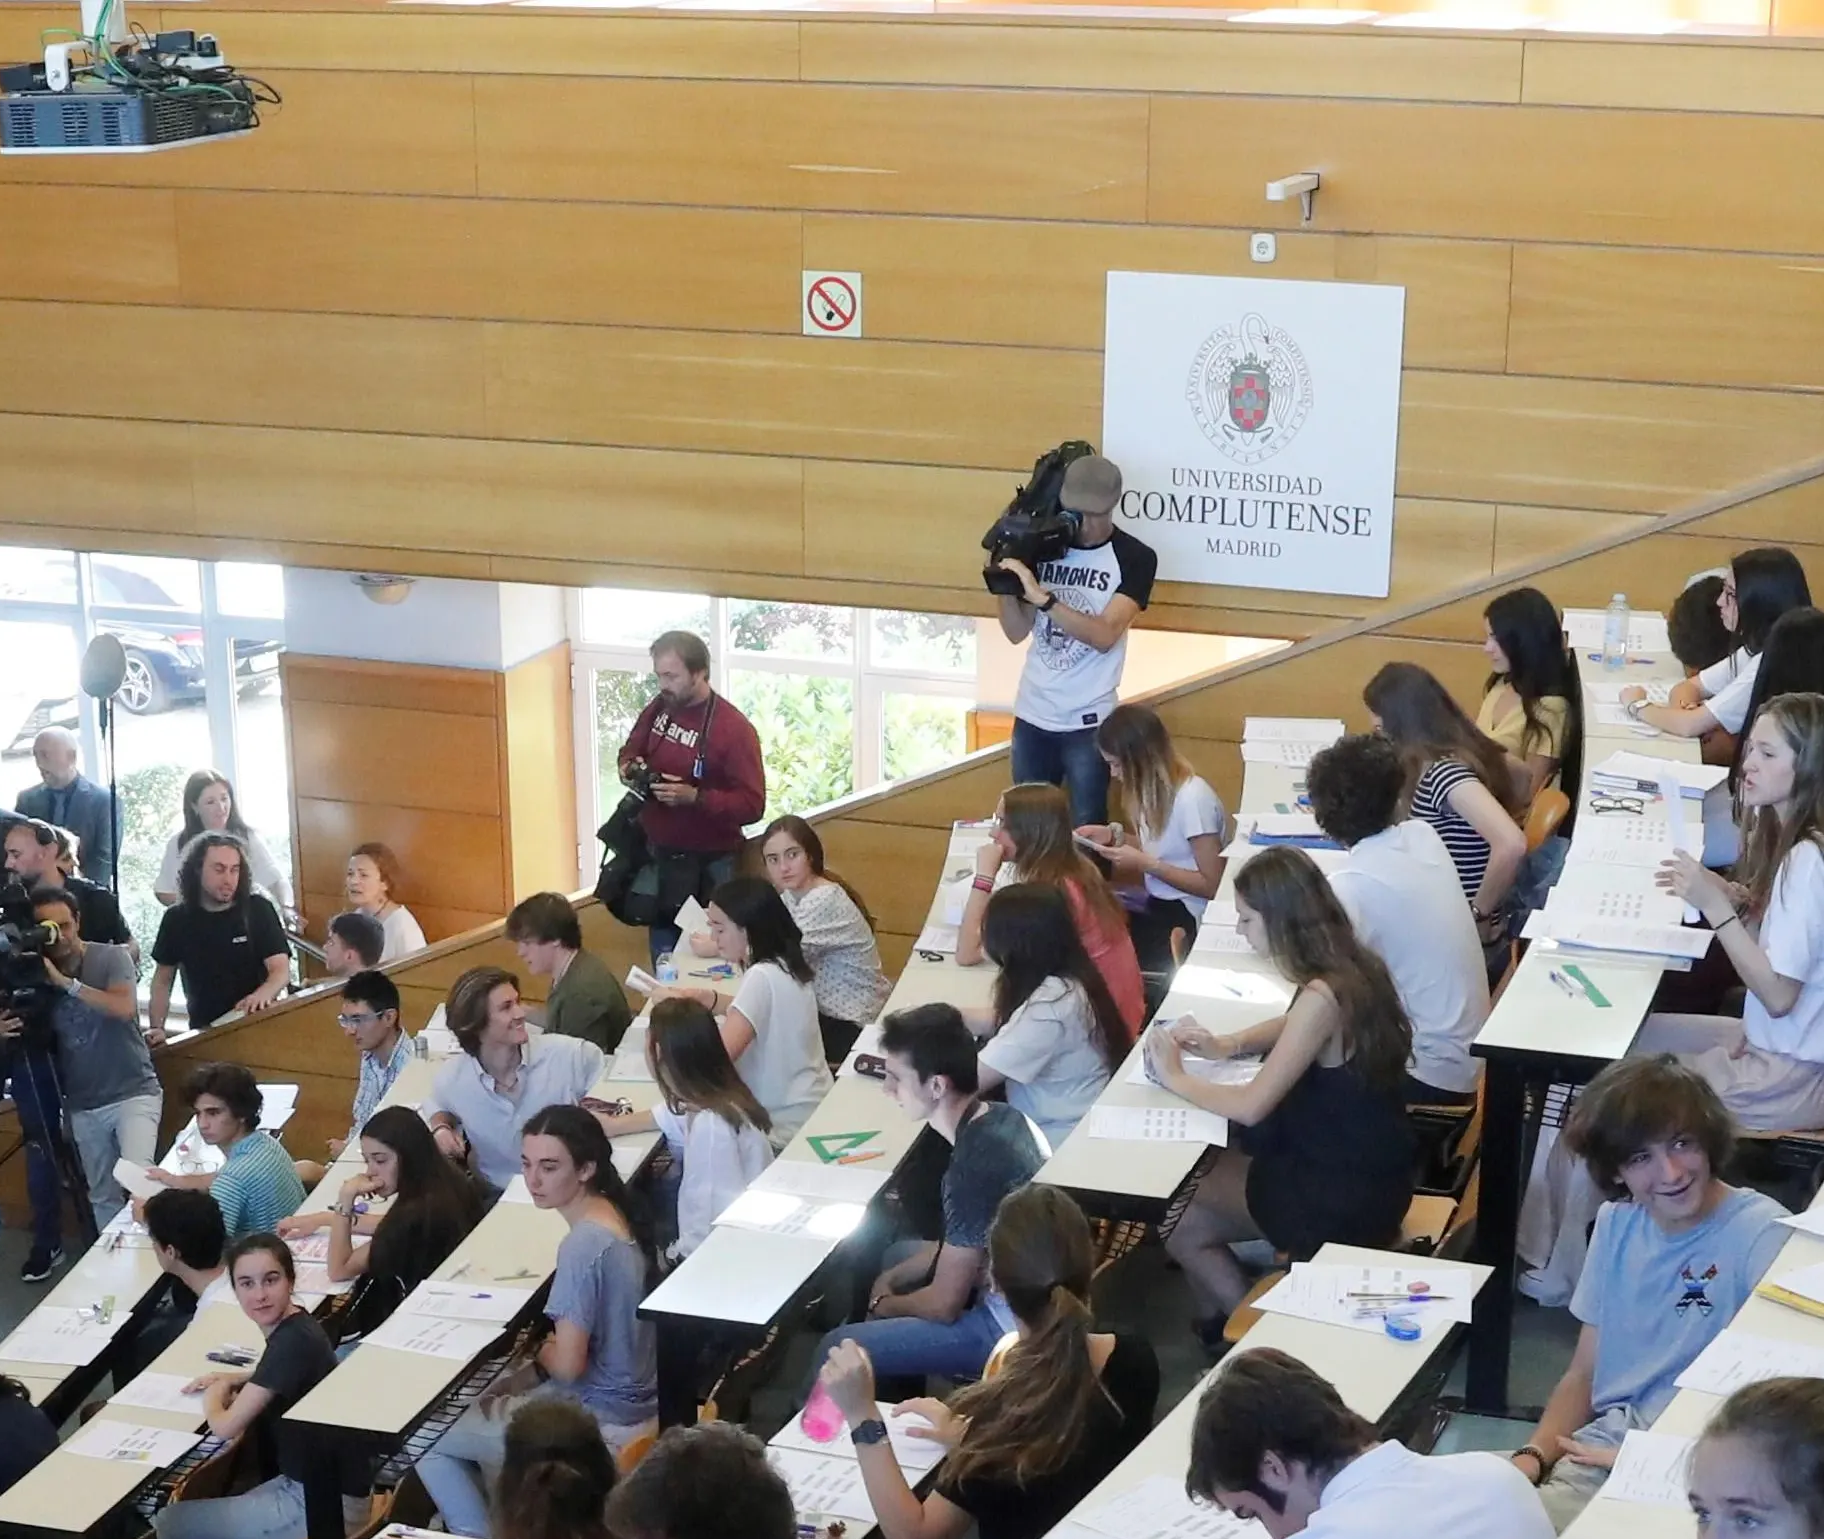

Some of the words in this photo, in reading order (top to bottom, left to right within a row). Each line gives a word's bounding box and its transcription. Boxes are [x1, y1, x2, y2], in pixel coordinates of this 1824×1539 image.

[1171, 467, 1323, 496] UNIVERSIDAD
[1120, 490, 1372, 537] COMPLUTENSE
[1206, 538, 1282, 558] MADRID
